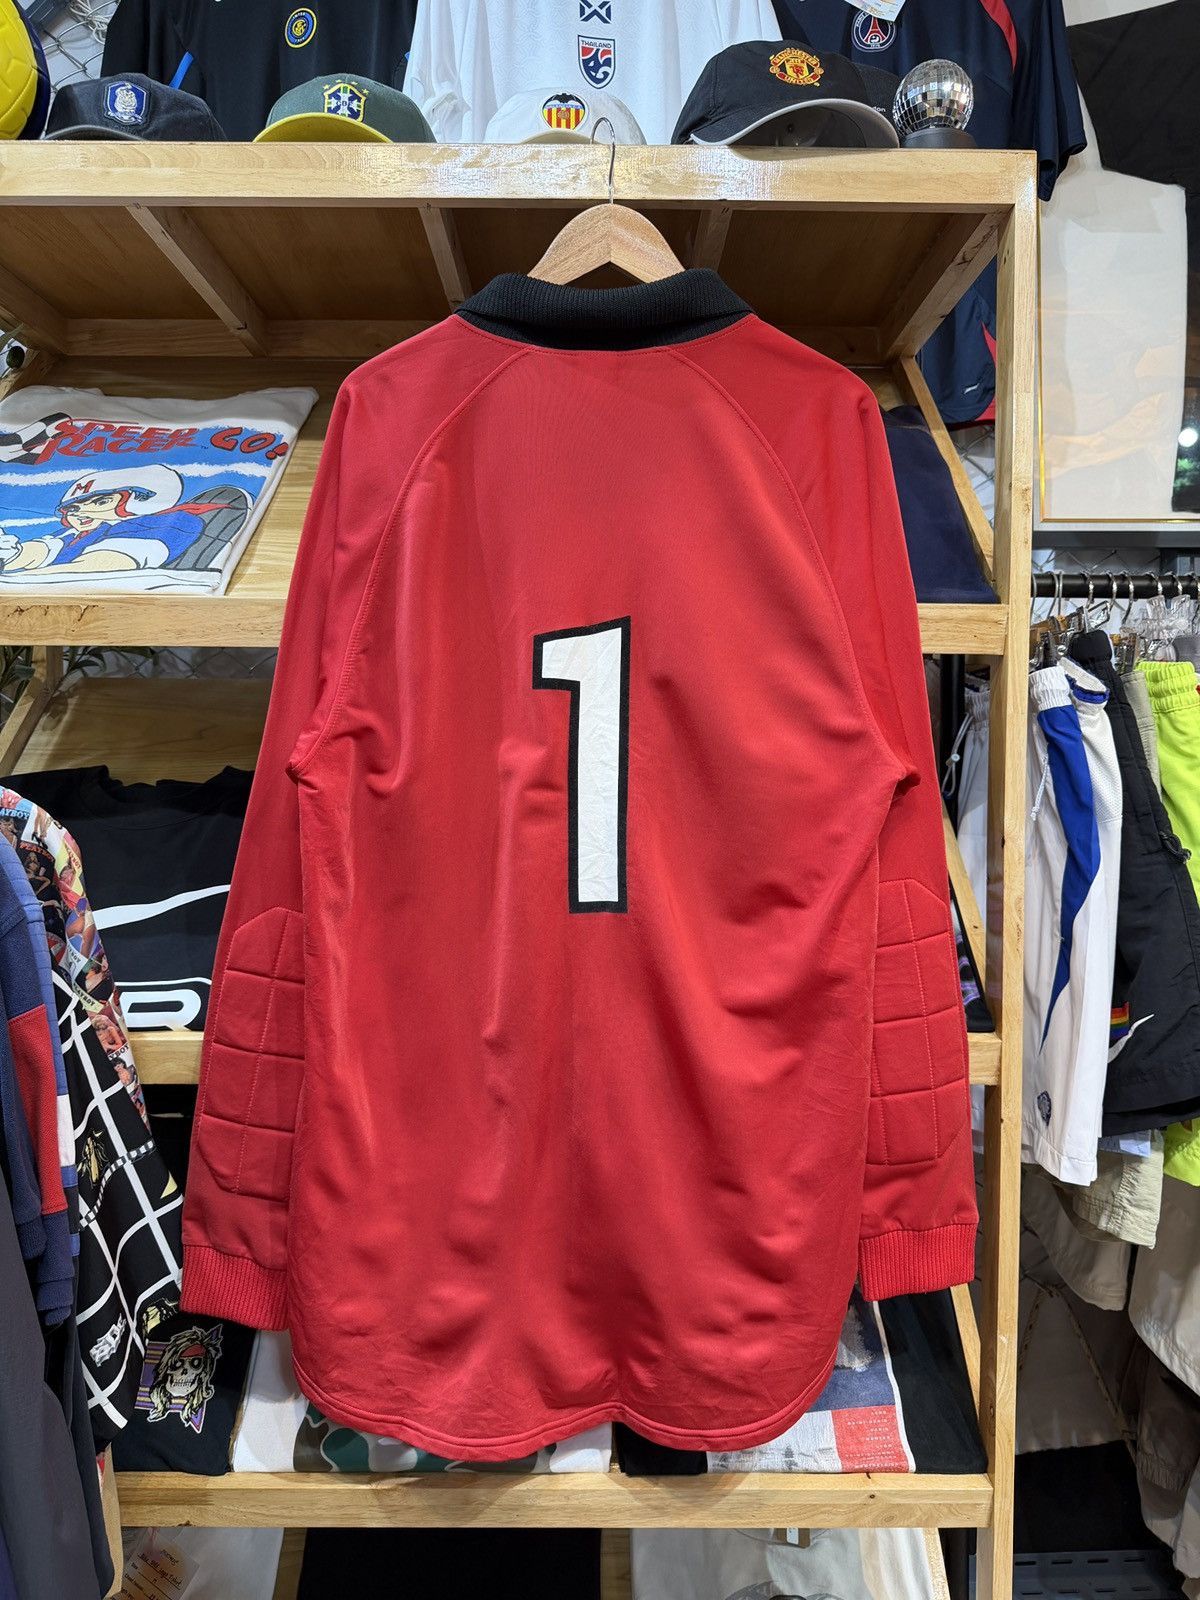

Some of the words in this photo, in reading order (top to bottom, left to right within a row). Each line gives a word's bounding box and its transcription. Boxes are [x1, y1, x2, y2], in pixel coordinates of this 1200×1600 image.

[581, 40, 612, 49] THAILAND
[772, 49, 819, 66] MANCHESTER
[784, 75, 813, 85] UNITED
[34, 434, 199, 465] RACER
[210, 427, 289, 460] GO!
[70, 479, 96, 497] M
[532, 615, 631, 914] 1
